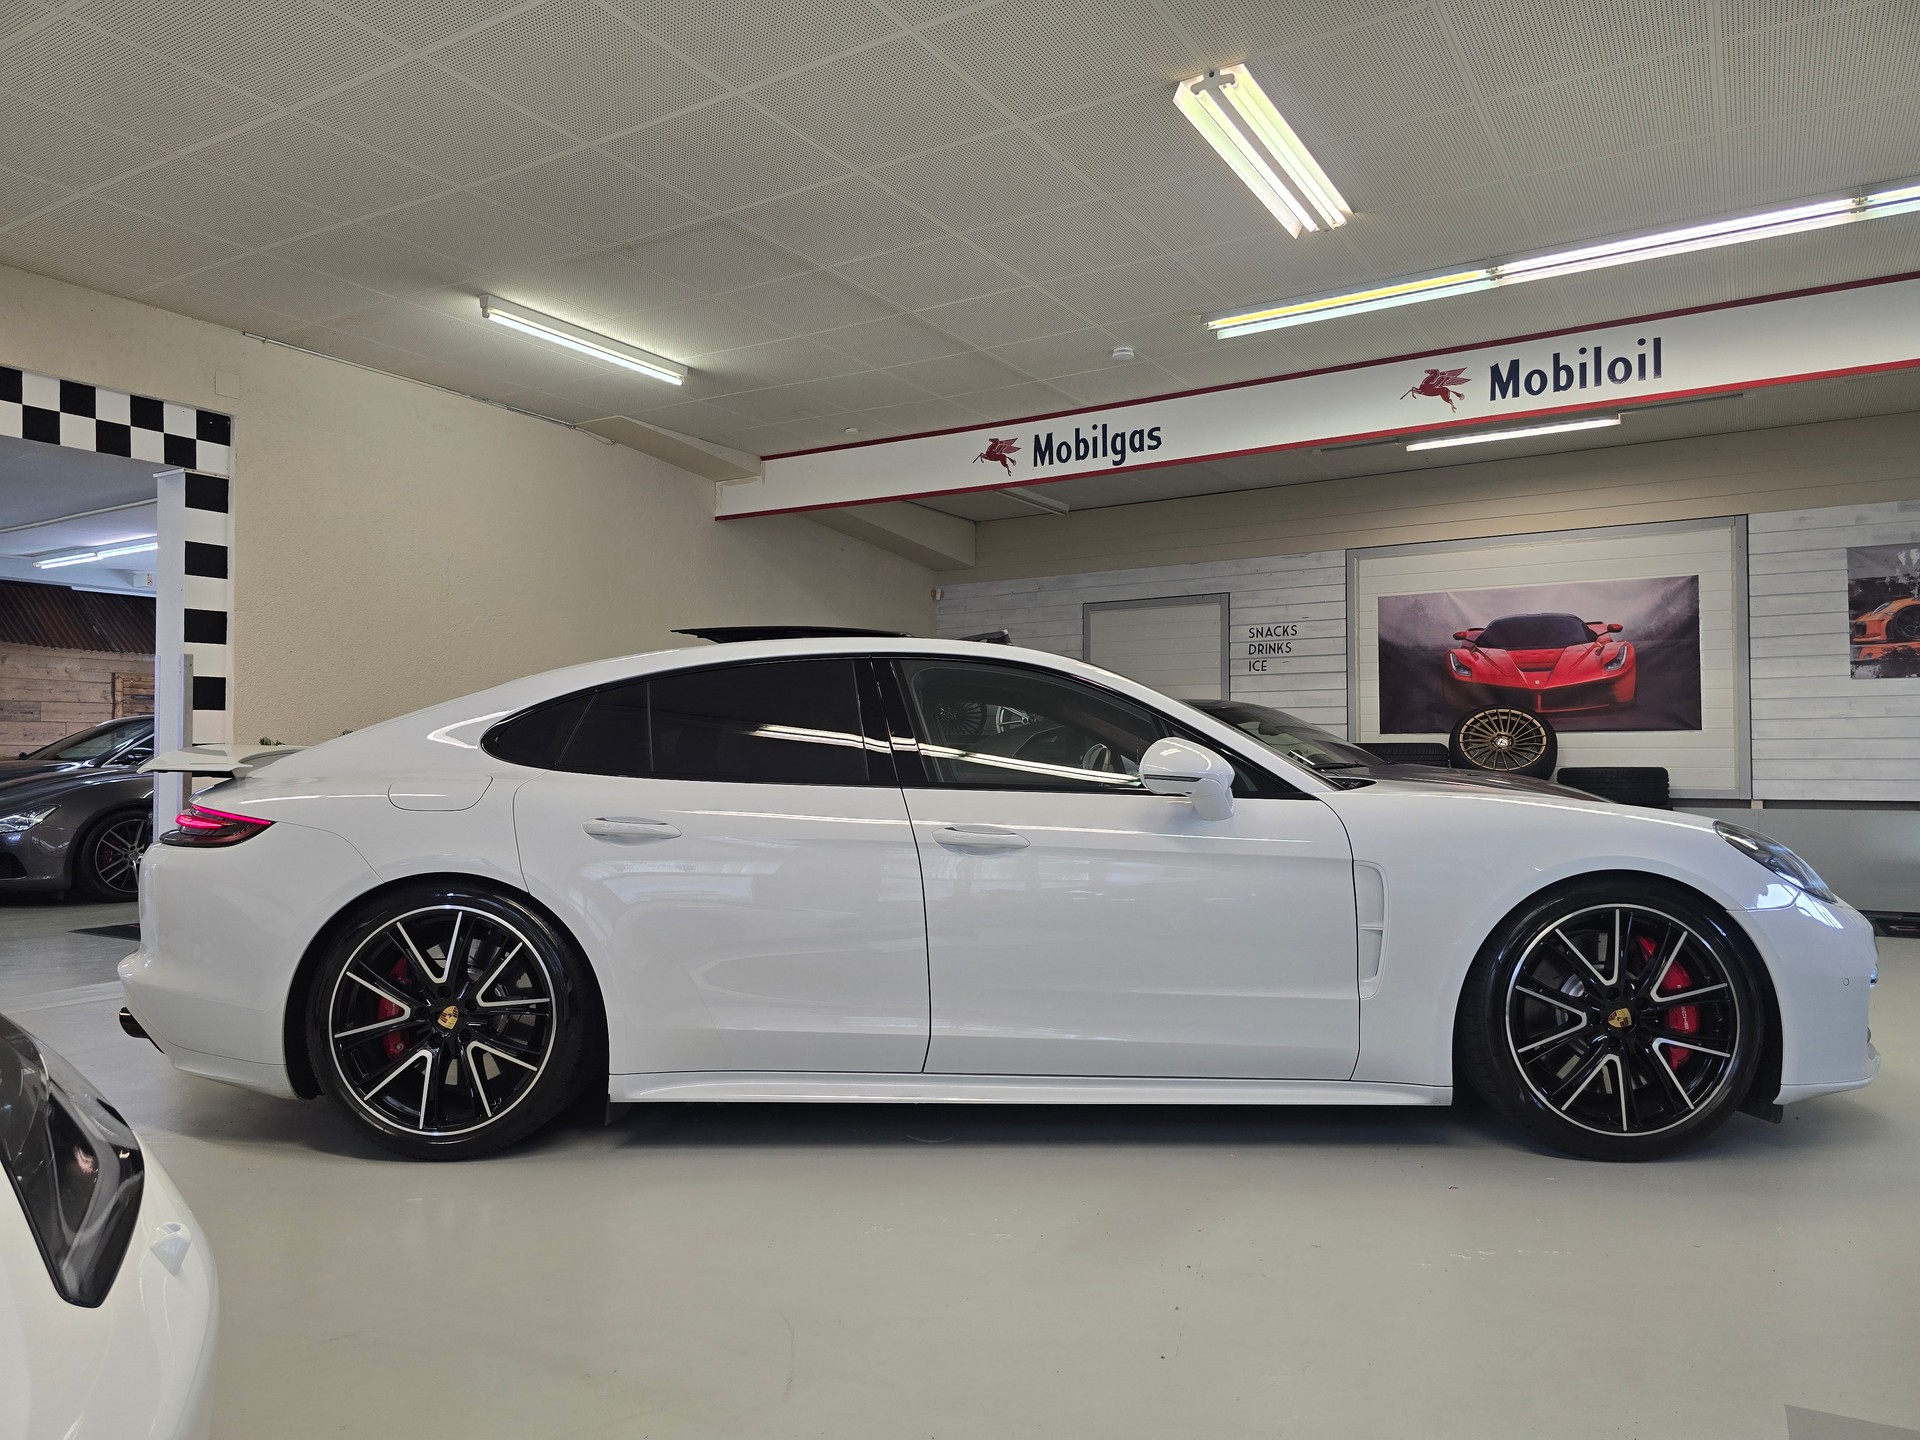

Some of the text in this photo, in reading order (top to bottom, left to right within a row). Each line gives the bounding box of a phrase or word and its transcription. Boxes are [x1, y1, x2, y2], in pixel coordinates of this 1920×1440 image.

[1489, 336, 1662, 402] Mobiloil
[1033, 423, 1162, 467] Mobilgas
[1248, 624, 1298, 639] SNACKS
[1248, 641, 1292, 655] DRINKS
[1248, 660, 1267, 672] ICE
